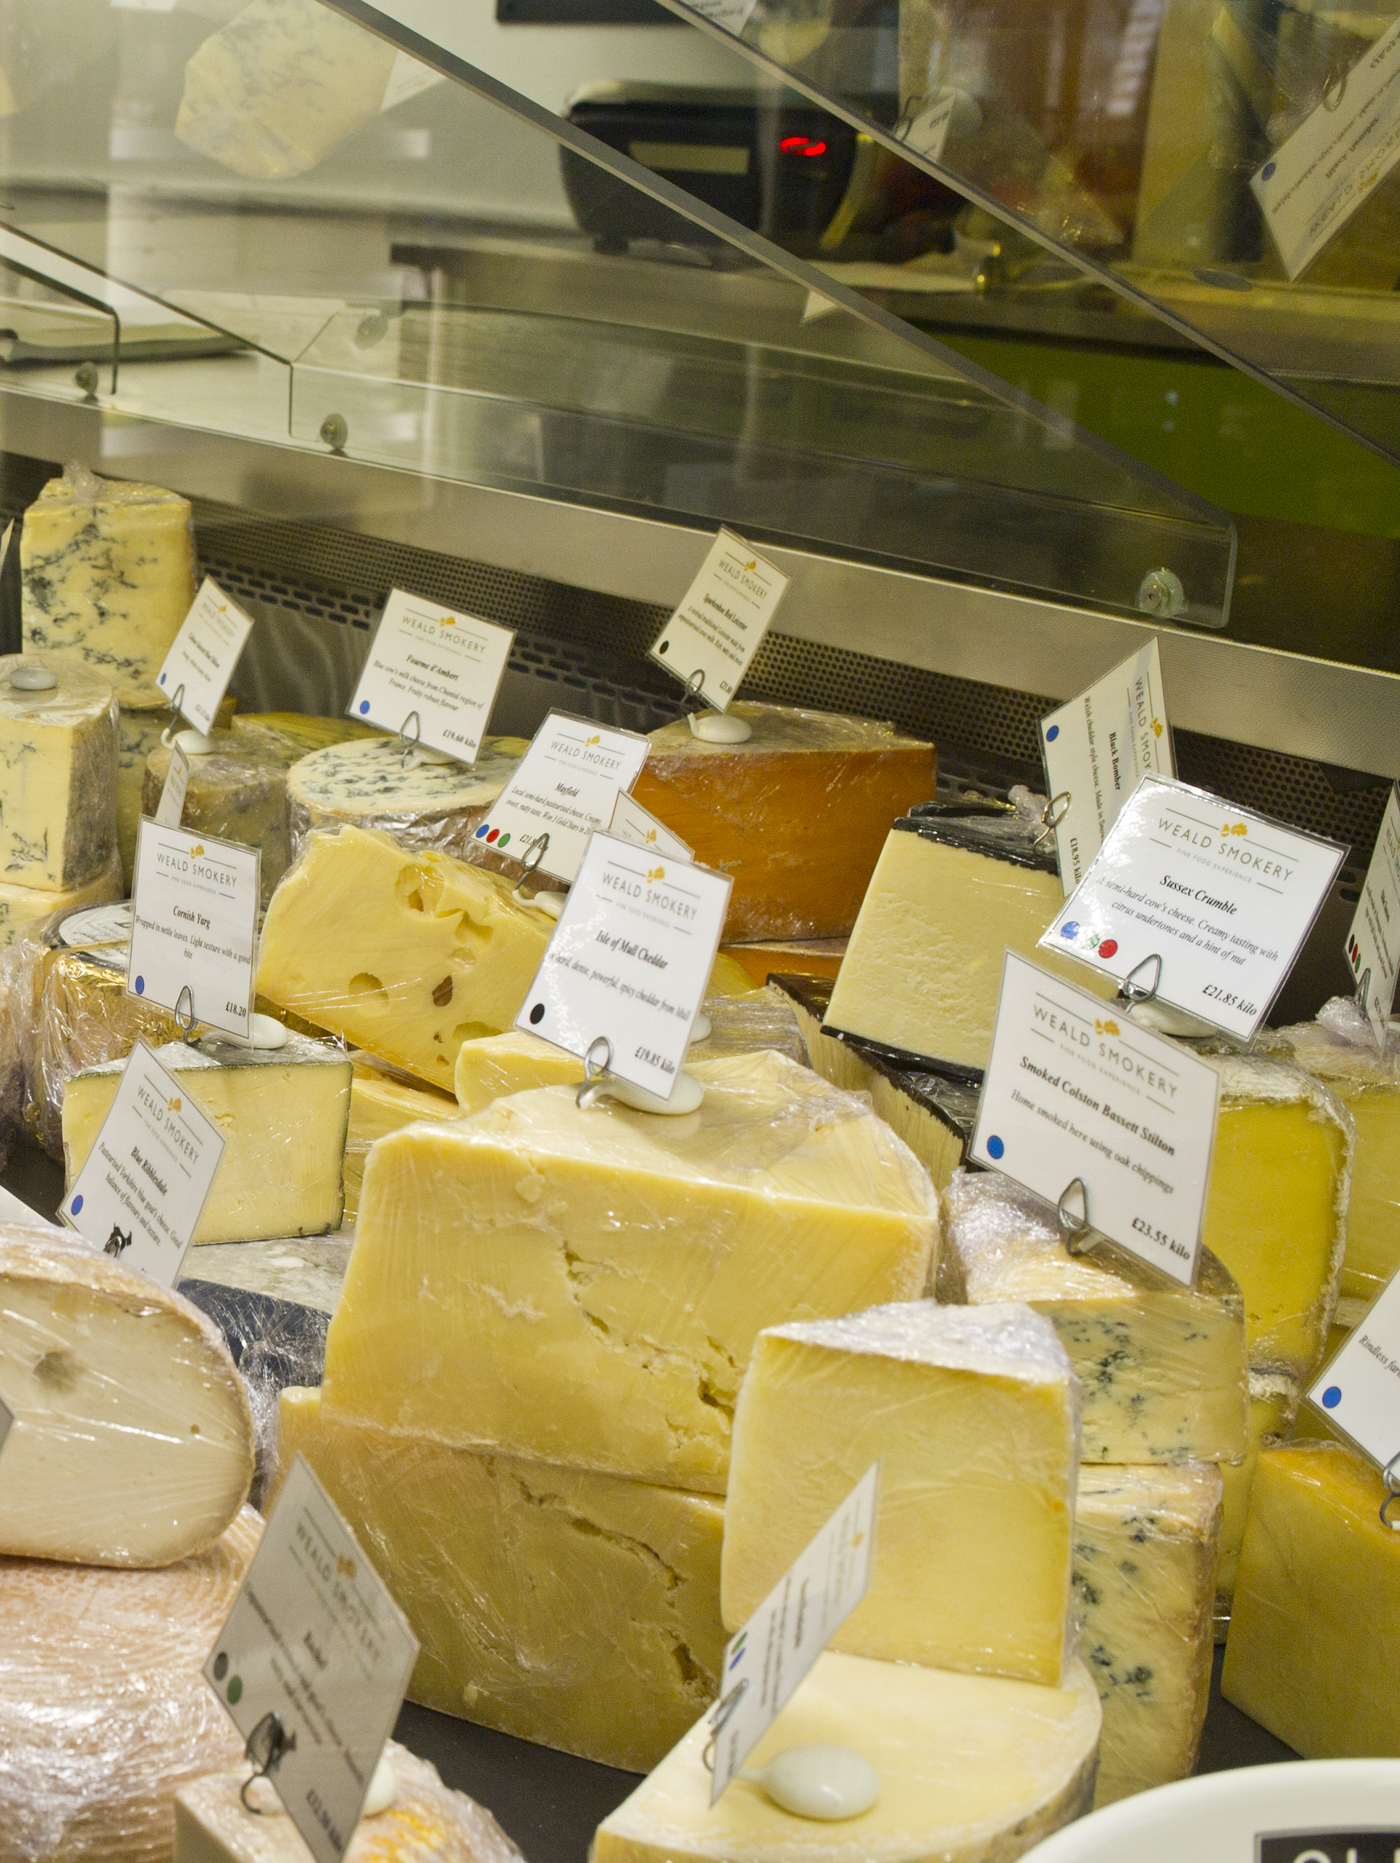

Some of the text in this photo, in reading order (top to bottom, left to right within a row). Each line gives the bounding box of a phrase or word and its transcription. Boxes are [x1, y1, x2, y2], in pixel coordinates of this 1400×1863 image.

[402, 615, 486, 653] WEALD SMOKERY
[406, 654, 459, 681] Fourme d'Ambert
[442, 729, 476, 748] £19.60 kilo
[1134, 676, 1152, 769] WEALD SMOK
[550, 740, 621, 770] WEALD SMOKERY
[1083, 695, 1103, 820] Welsh cheddar style cheese. Made in
[1108, 731, 1121, 790] Black Bomber
[554, 782, 580, 797] Mayfield
[157, 852, 237, 887] WEALD SMOKERY
[1069, 837, 1082, 884] £18.95 kilo
[1158, 817, 1293, 881] WEALD SMOKERY
[1176, 847, 1252, 883] FINE FOOD EXPERIENCE
[602, 872, 697, 920] WEALD SMOKERY
[1159, 874, 1237, 915] Sussex Crumble
[172, 905, 210, 930] Cornish Yarg
[1105, 880, 1147, 902] semi-hard
[1143, 898, 1167, 912] cow's
[1166, 907, 1195, 925] cheese.
[1197, 919, 1230, 941] Creamy
[1229, 934, 1259, 954] tasting
[1259, 947, 1278, 961] with
[1110, 901, 1135, 916] citrus
[1134, 911, 1179, 935] undertones
[1178, 931, 1198, 943] and
[1202, 939, 1221, 954] hint
[1219, 950, 1234, 960] of
[1229, 954, 1246, 965] nut
[134, 914, 155, 930] Wrapped
[154, 923, 160, 932] in
[160, 926, 173, 937] nettle
[172, 928, 188, 942] leaves.
[189, 934, 203, 948] Light
[202, 941, 221, 954] texture
[221, 947, 233, 958] with
[237, 954, 252, 964] good
[183, 947, 193, 959] bite
[595, 929, 668, 969] Isle of Mull Cheddar
[225, 1001, 246, 1017] £18.20
[1201, 984, 1257, 1015] £21.85 kilo
[634, 1046, 675, 1074] £19.85 kilo
[1033, 1004, 1177, 1097] WEALD SMOKERY
[137, 1084, 199, 1163] WEALD SMOKERY
[1019, 1055, 1175, 1156] Smoked Colston Bassett Stilton
[1010, 1088, 1174, 1194] Home smoked here using oak chippings
[130, 1146, 167, 1196] Blue Ribblesdale
[1131, 1216, 1190, 1260] £23.55 kilo
[1357, 1333, 1390, 1366] Rindless
